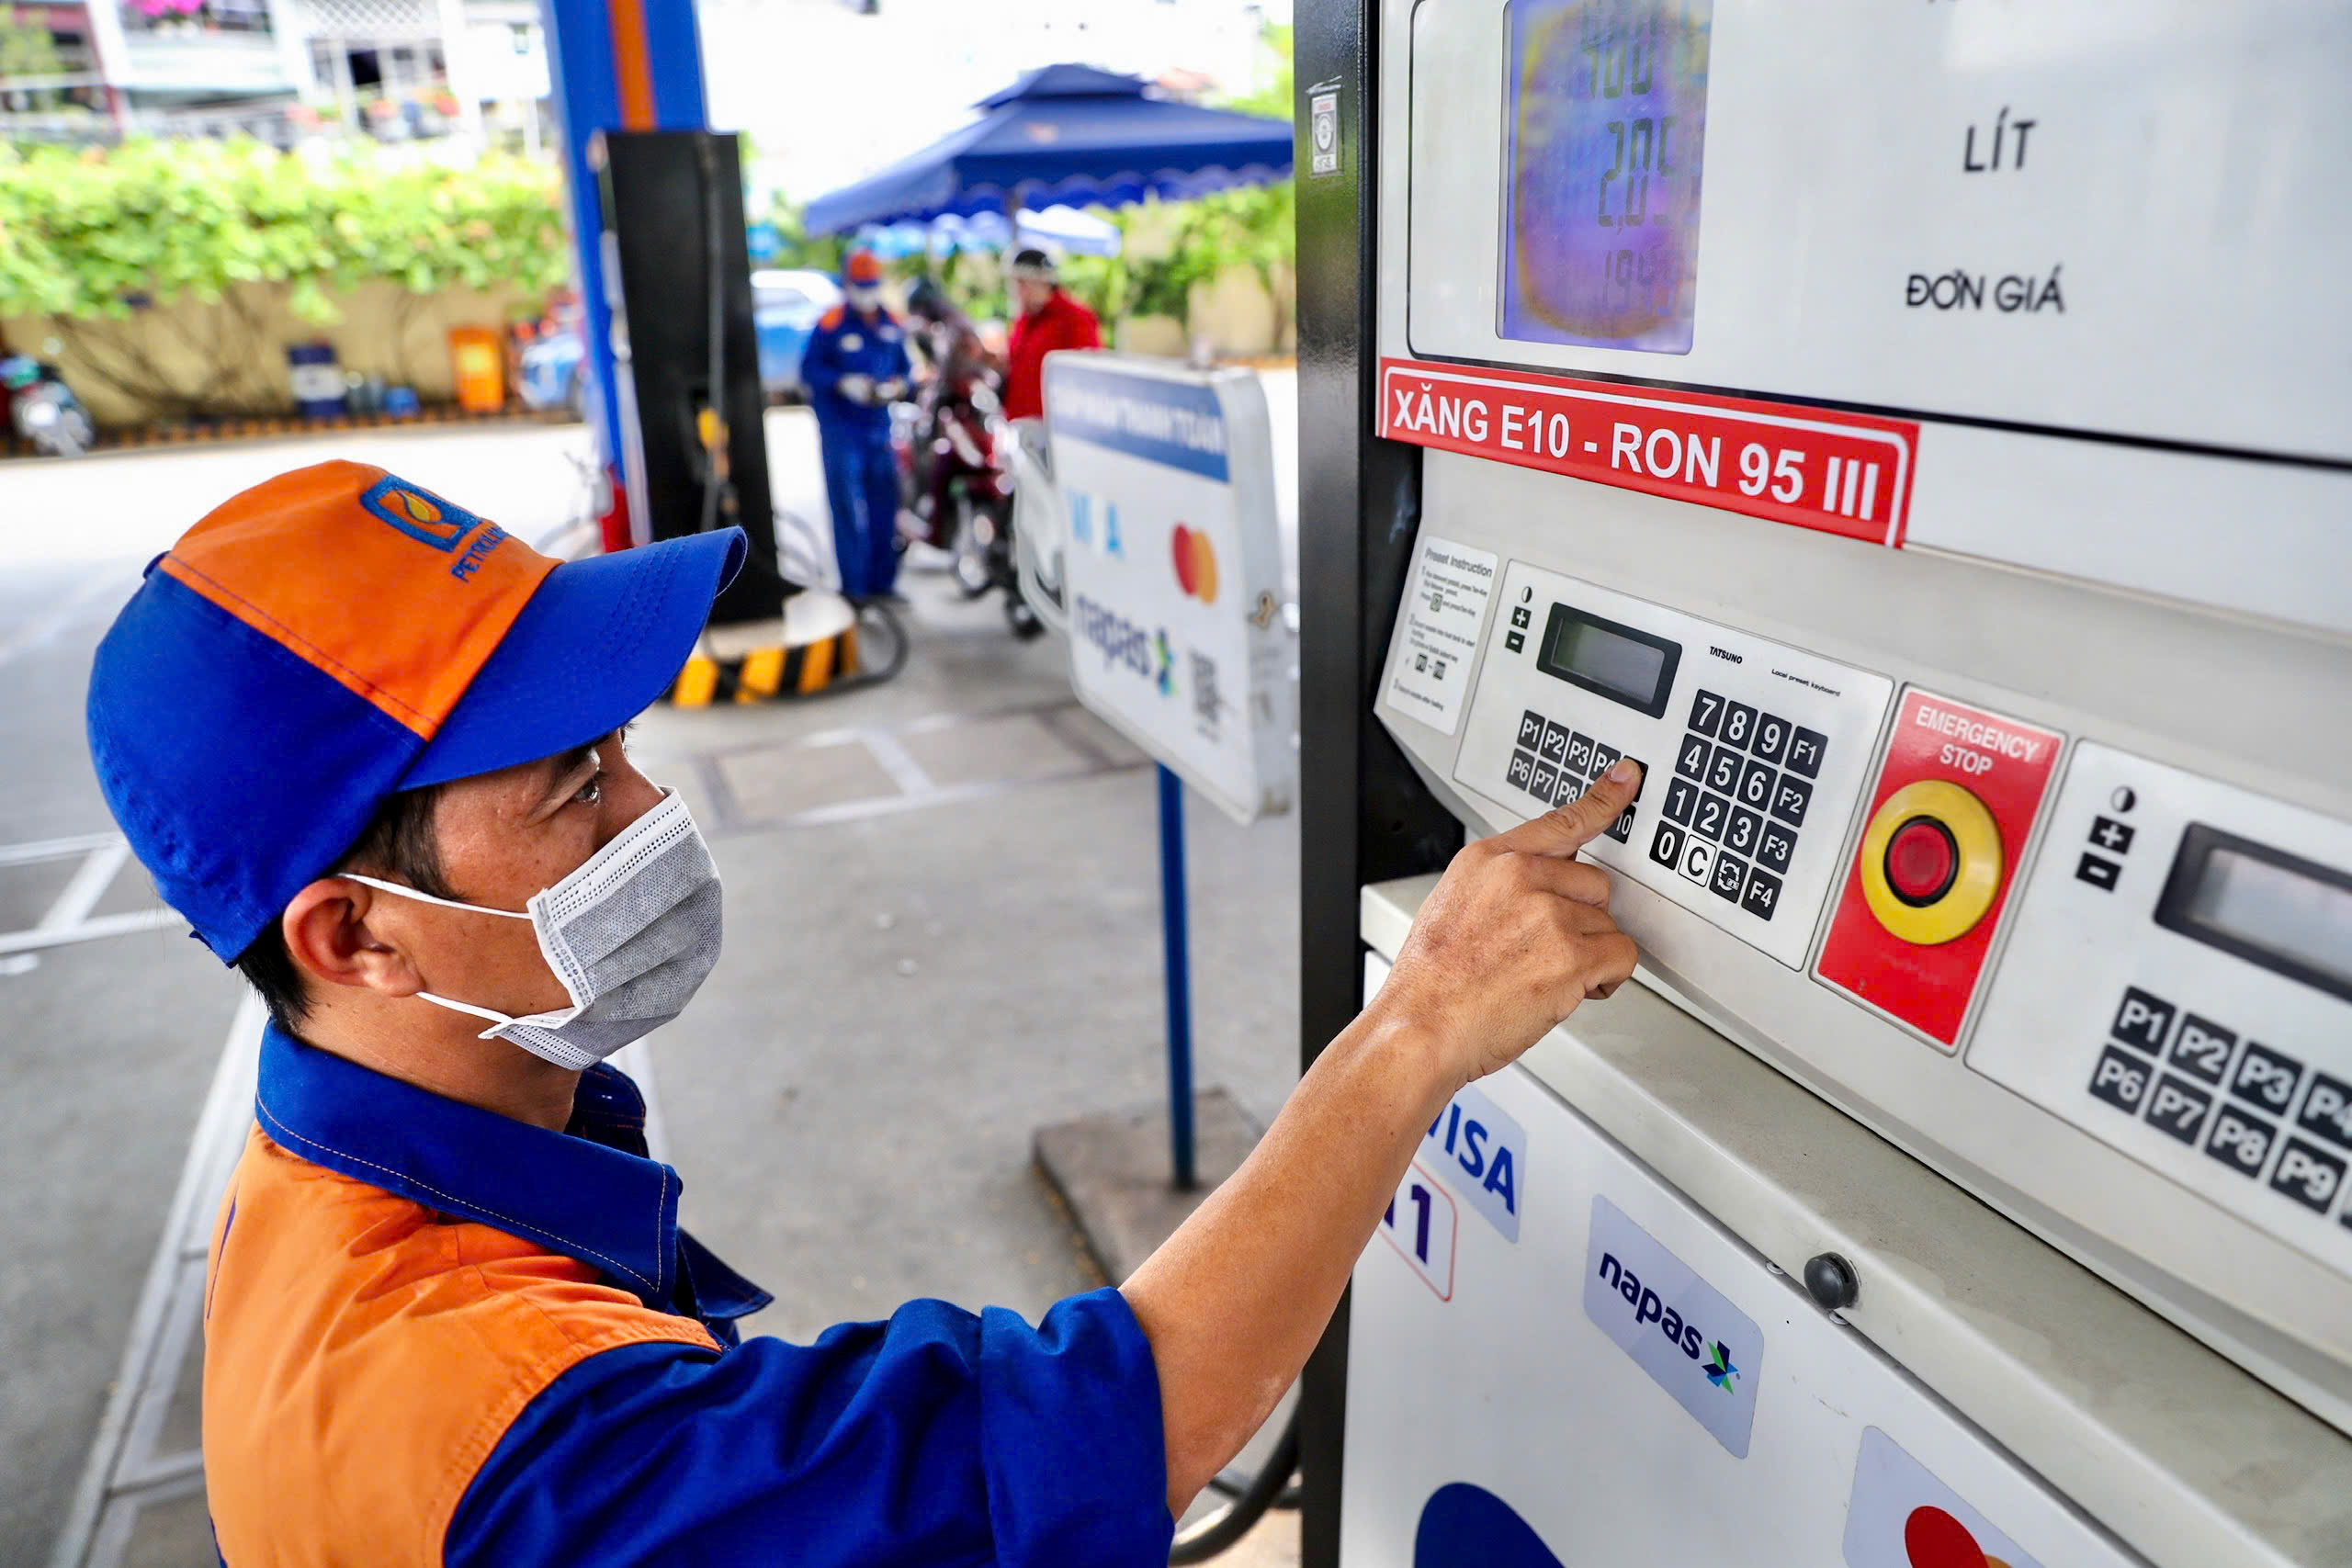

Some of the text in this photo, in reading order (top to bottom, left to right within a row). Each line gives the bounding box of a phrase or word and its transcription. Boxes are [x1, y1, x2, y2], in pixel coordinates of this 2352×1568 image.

[1962, 106, 2038, 173] LÍT
[1905, 264, 2064, 313] ĐƠN GIÁ
[1394, 383, 1488, 442] XĂNG
[1501, 405, 1570, 458] E10
[1611, 422, 1722, 488] RON
[1738, 443, 1805, 503] 95
[1823, 457, 1879, 521] III
[1450, 556, 1493, 578] Instruction
[1710, 646, 1743, 664] TATSUNO
[1771, 668, 1840, 696] Local preset keyboard
[1521, 718, 1540, 743] P1
[1544, 729, 1565, 755] P2
[1568, 740, 1589, 767] P3
[1702, 697, 1817, 765] 7 8 9 F1
[1916, 705, 2040, 762] EMERGENCY
[1939, 743, 1993, 775] STOP
[1510, 757, 1578, 805] P6 P7 P8
[1684, 744, 1804, 814] 4 5 6 F2
[1617, 811, 1632, 835] 10
[1675, 788, 1789, 862] 1 2 3 F3
[1658, 830, 1676, 861] 0
[1687, 846, 1708, 877] C
[1749, 881, 1773, 908] F4
[2119, 998, 2166, 1043] P1
[2176, 1026, 2224, 1074] P2
[2237, 1053, 2297, 1106] P3
[2096, 1057, 2144, 1102] P6
[2152, 1085, 2205, 1131] P7
[2211, 1112, 2268, 1168] P8
[2277, 1147, 2339, 1202] P9
[1599, 1252, 1702, 1360] napas
